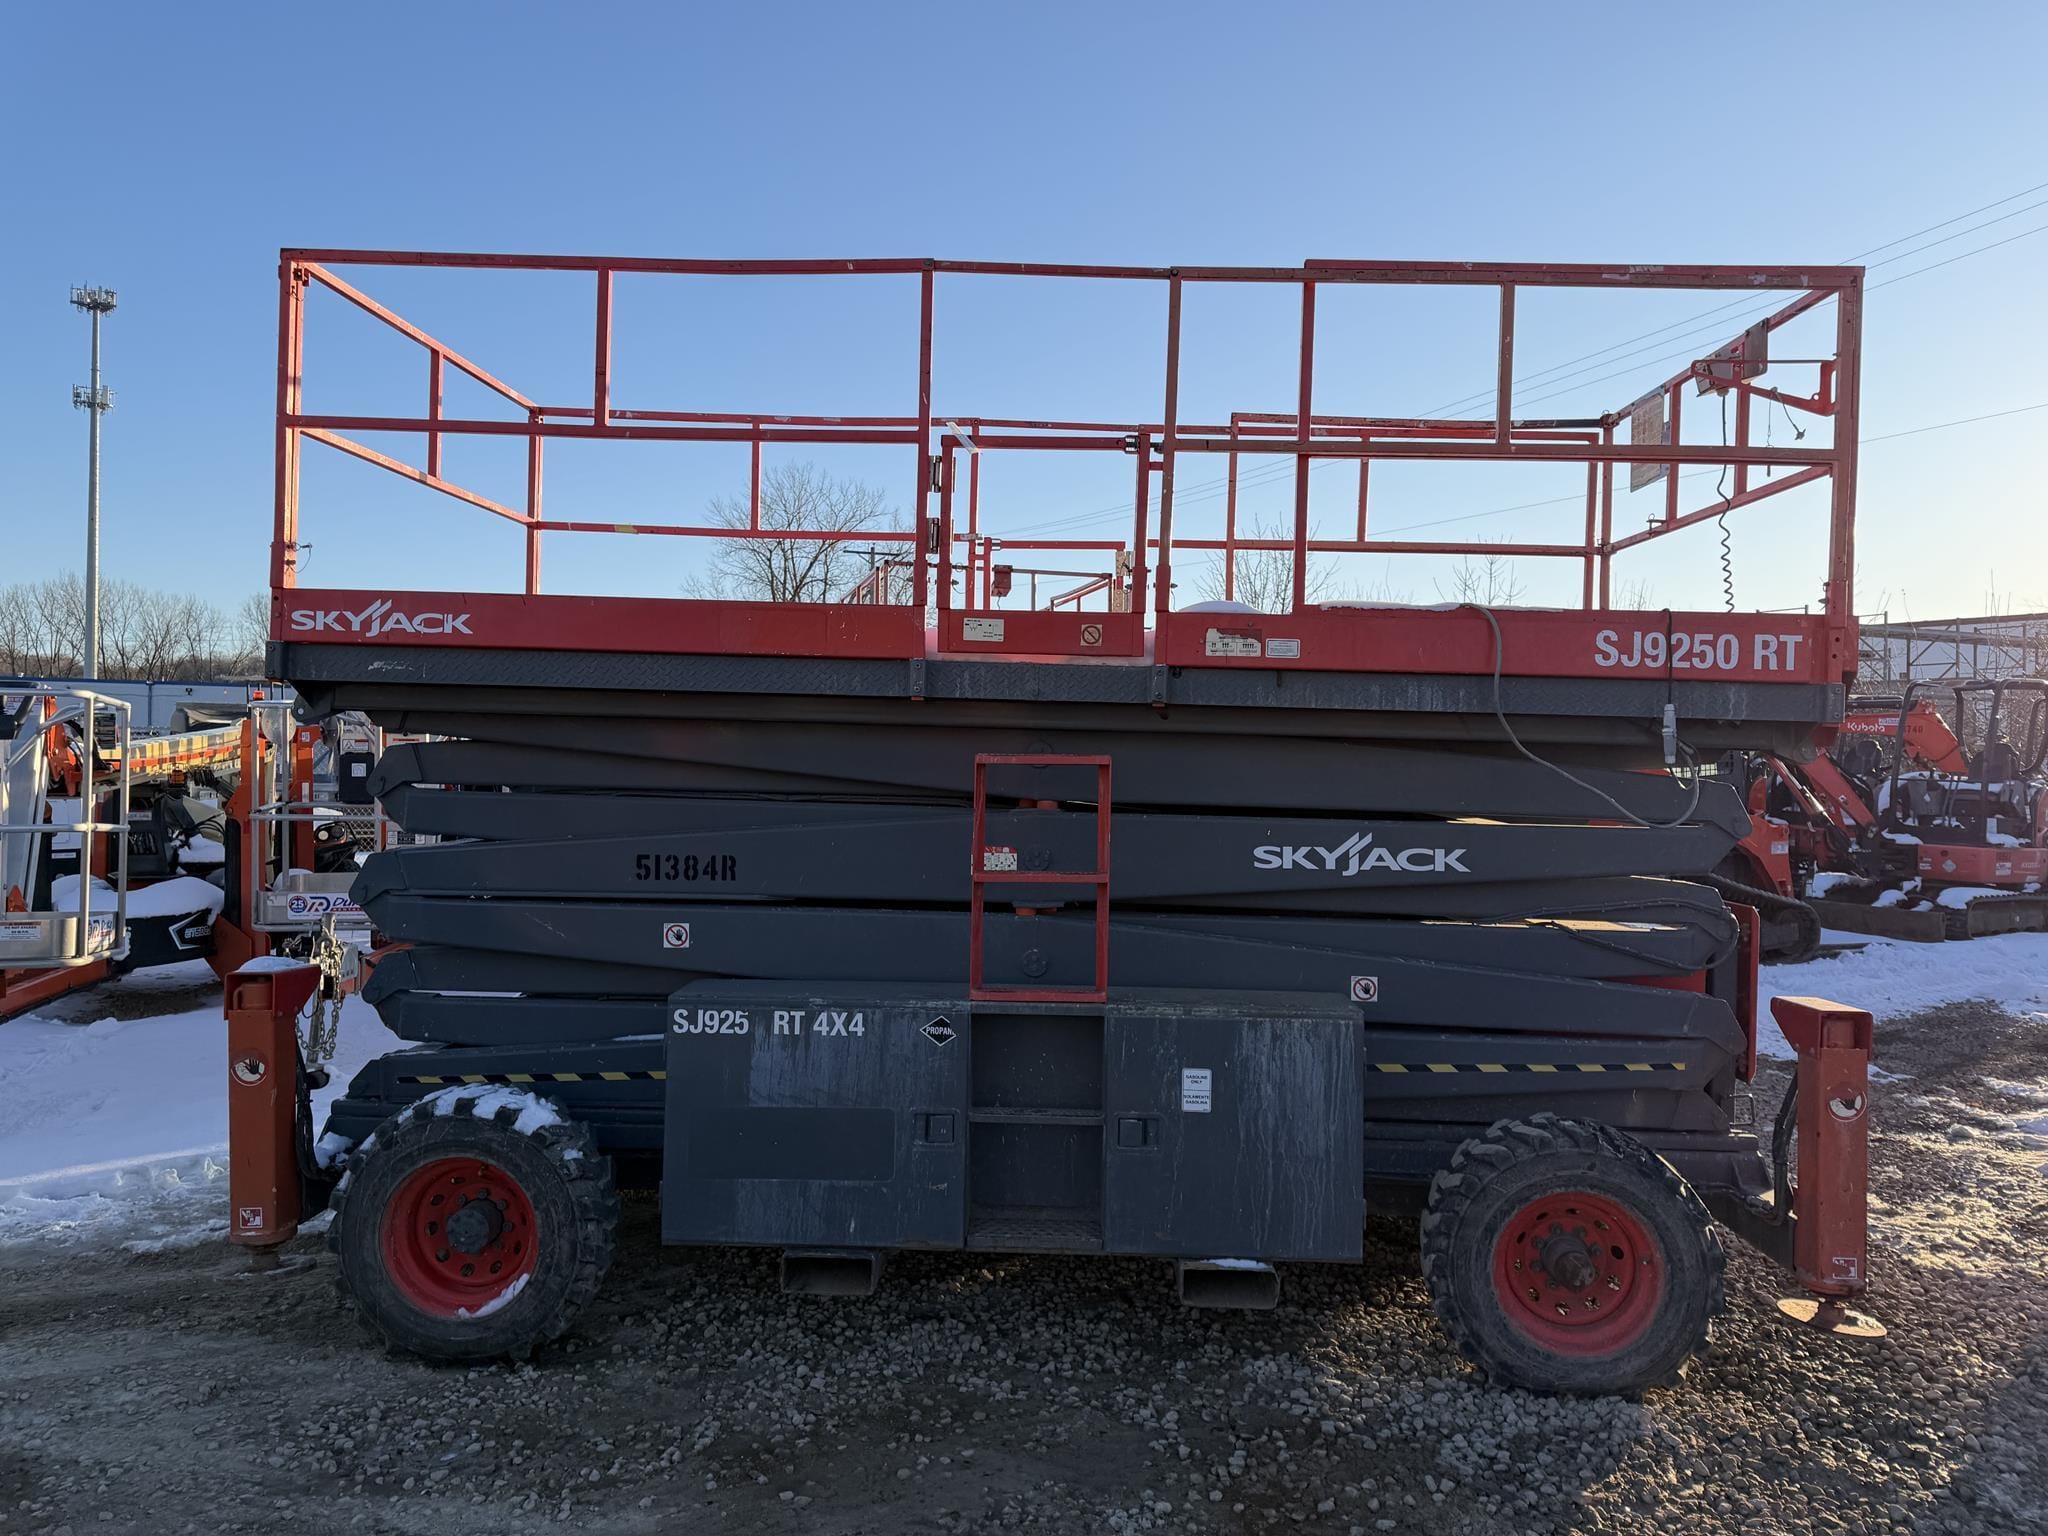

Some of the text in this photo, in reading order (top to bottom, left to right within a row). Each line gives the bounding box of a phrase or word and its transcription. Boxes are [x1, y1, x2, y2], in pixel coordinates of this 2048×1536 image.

[291, 599, 473, 638] SKYJACK
[1594, 629, 1803, 671] SJ9250 RT
[1847, 722, 1886, 732] Kubota
[635, 854, 737, 881] 51384R
[1253, 832, 1472, 877] SKYJACK
[291, 900, 304, 908] 25
[672, 1008, 865, 1037] SJ925 RT 4X4
[926, 1026, 955, 1036] PROPAN
